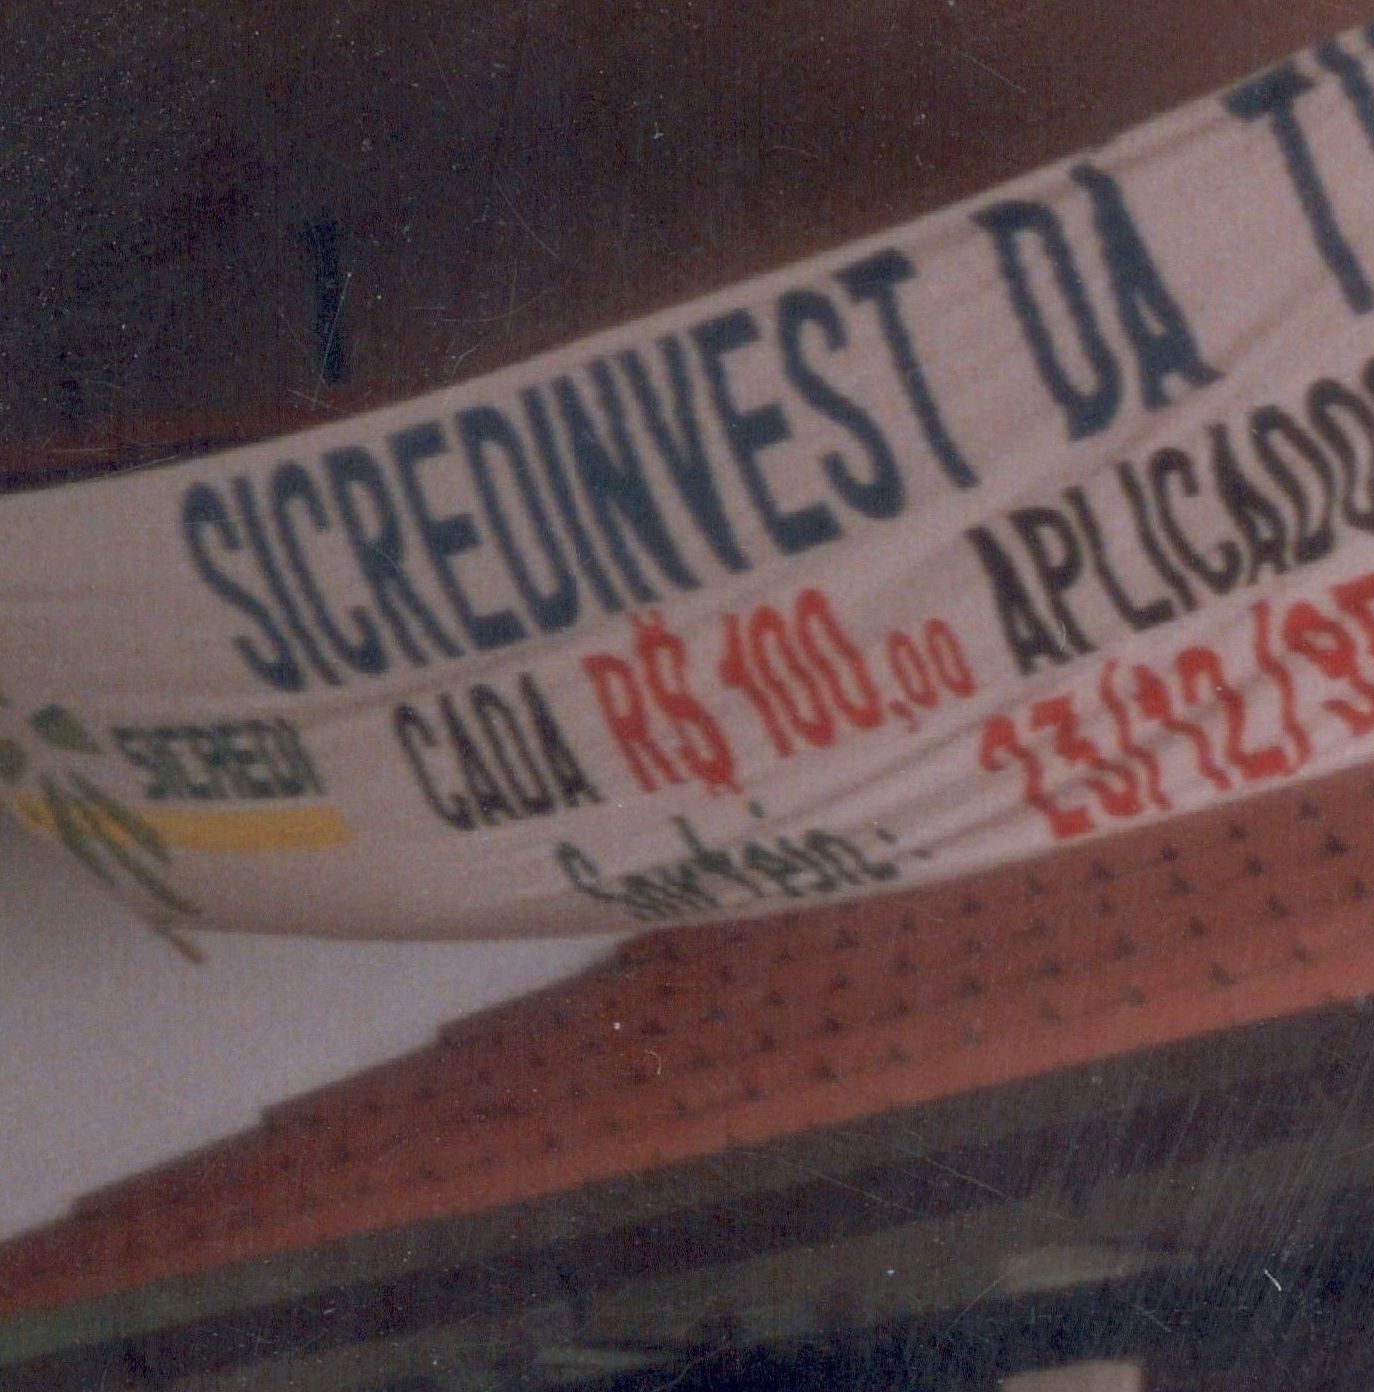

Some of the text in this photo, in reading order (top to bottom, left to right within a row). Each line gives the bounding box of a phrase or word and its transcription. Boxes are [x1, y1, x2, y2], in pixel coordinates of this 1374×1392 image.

[182, 247, 982, 692] SICREDINVEST
[968, 162, 1224, 442] DA
[112, 714, 328, 801] SICREDI
[392, 672, 606, 832] CADA
[580, 607, 743, 796] R$
[714, 588, 977, 758] 100,00
